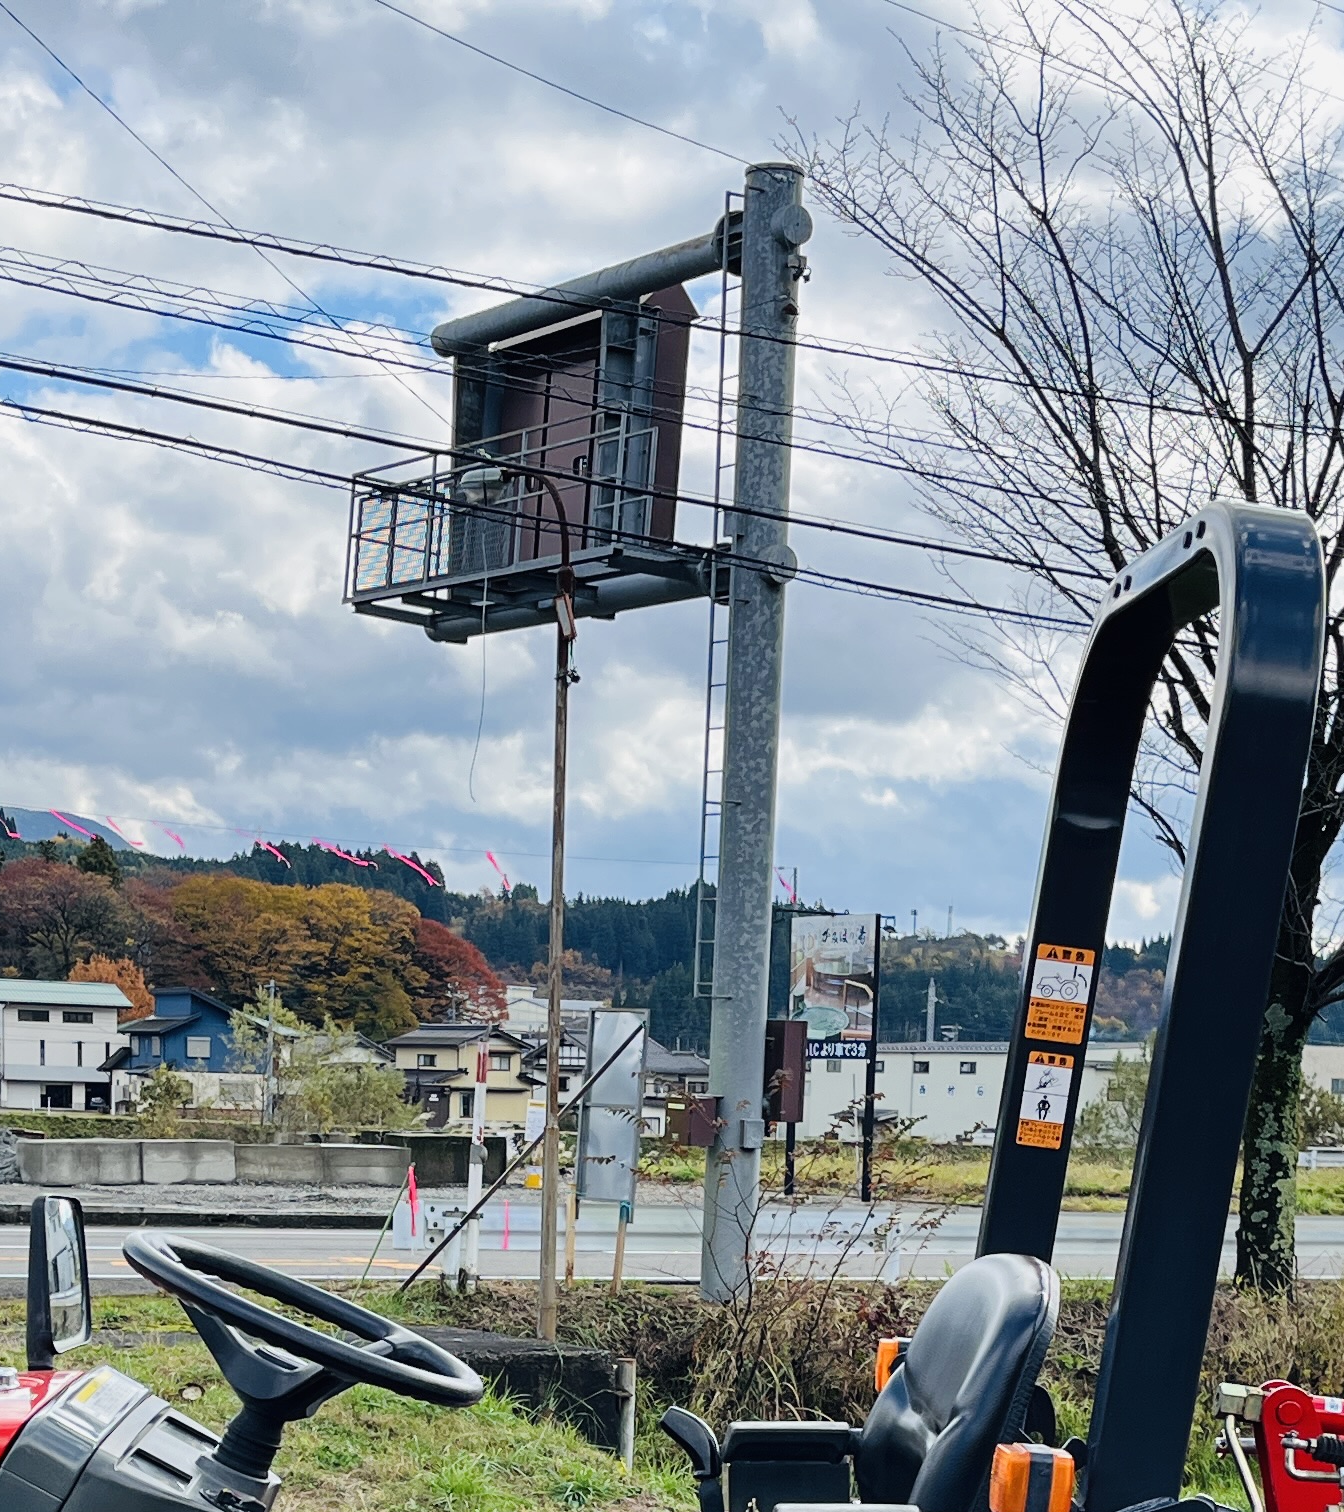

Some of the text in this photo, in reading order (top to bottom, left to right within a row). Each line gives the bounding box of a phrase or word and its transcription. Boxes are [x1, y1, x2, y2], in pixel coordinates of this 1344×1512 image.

[806, 1042, 867, 1058] ICより車で3分
